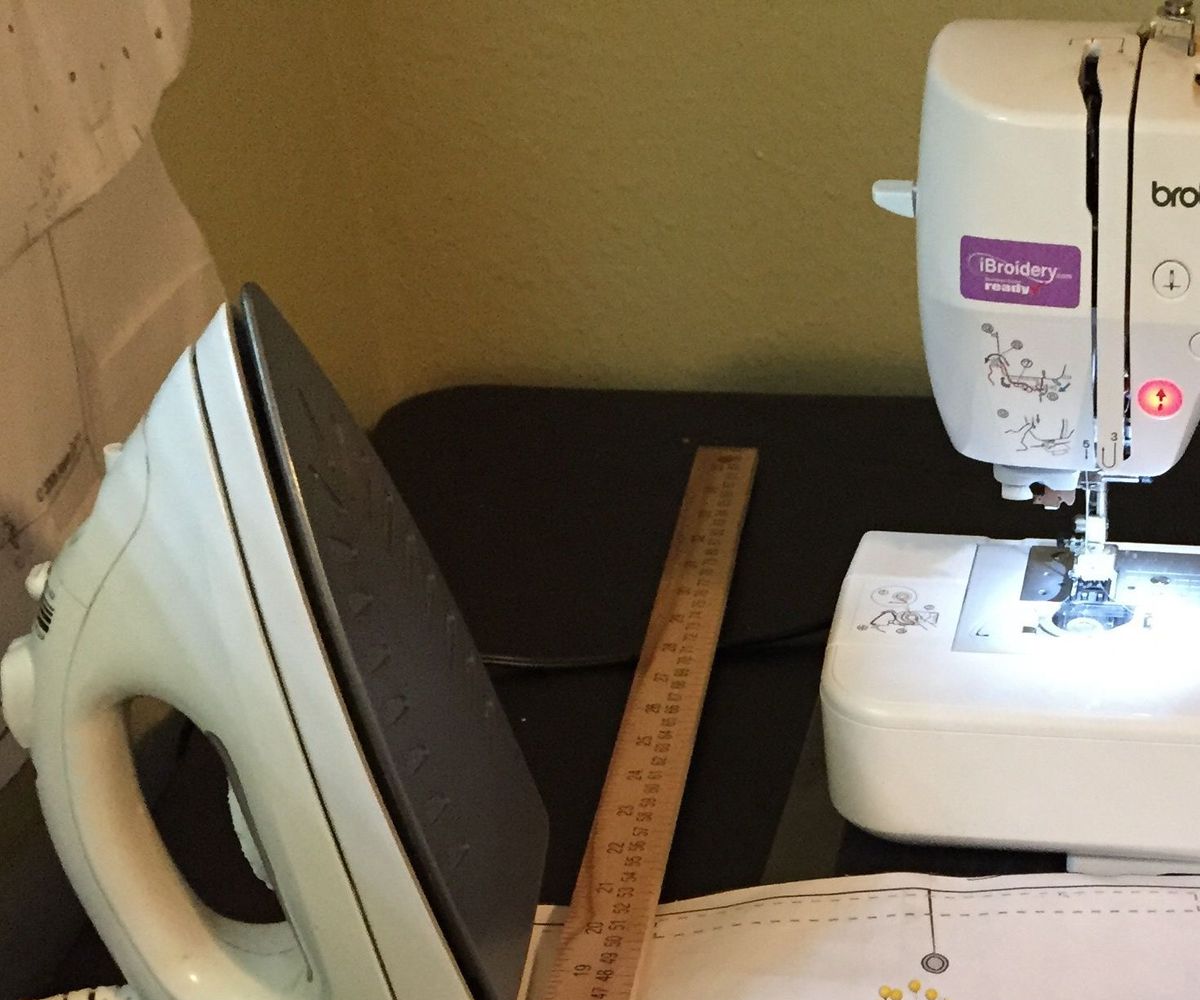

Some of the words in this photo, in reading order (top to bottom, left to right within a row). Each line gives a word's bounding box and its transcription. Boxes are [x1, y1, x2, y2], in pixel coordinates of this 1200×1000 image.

[984, 282, 1030, 295] ready
[1111, 432, 1118, 441] 3
[626, 770, 643, 781] 24
[616, 805, 634, 817] 23
[607, 841, 625, 854] 22
[629, 840, 647, 851] 56
[624, 855, 643, 867] 55
[621, 872, 638, 883] 54
[596, 882, 615, 894] 21
[616, 886, 635, 898] 53
[612, 902, 631, 915] 52
[585, 921, 604, 935] 20
[608, 920, 627, 931] 51
[603, 935, 623, 948] 50
[600, 952, 619, 964] 49
[573, 964, 592, 977] 19
[595, 969, 615, 982] 48
[591, 986, 610, 999] 47
